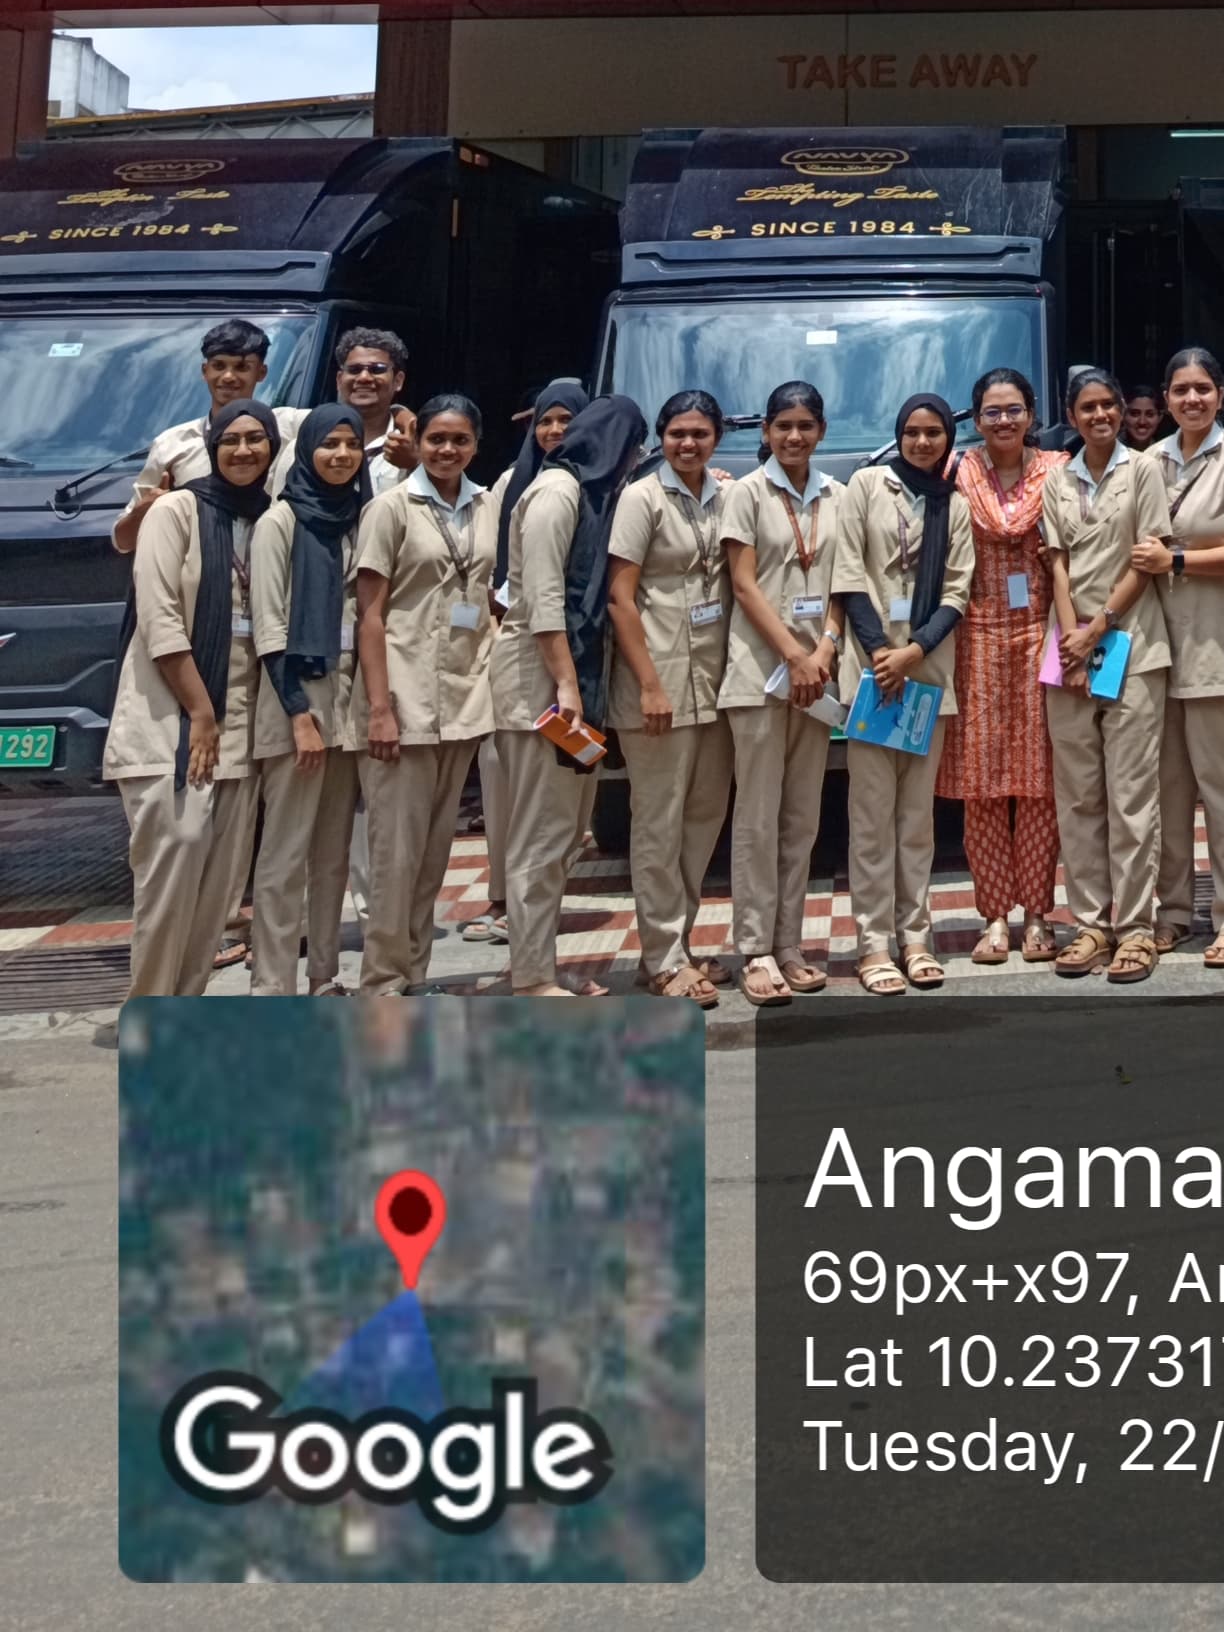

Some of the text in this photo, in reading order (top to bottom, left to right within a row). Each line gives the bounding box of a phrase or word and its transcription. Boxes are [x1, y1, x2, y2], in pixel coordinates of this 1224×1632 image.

[776, 53, 1038, 89] TAKE AWAY
[736, 185, 939, 207] Tempting Taste
[48, 223, 191, 239] SINCE 1984
[751, 220, 916, 236] SINCE 1984
